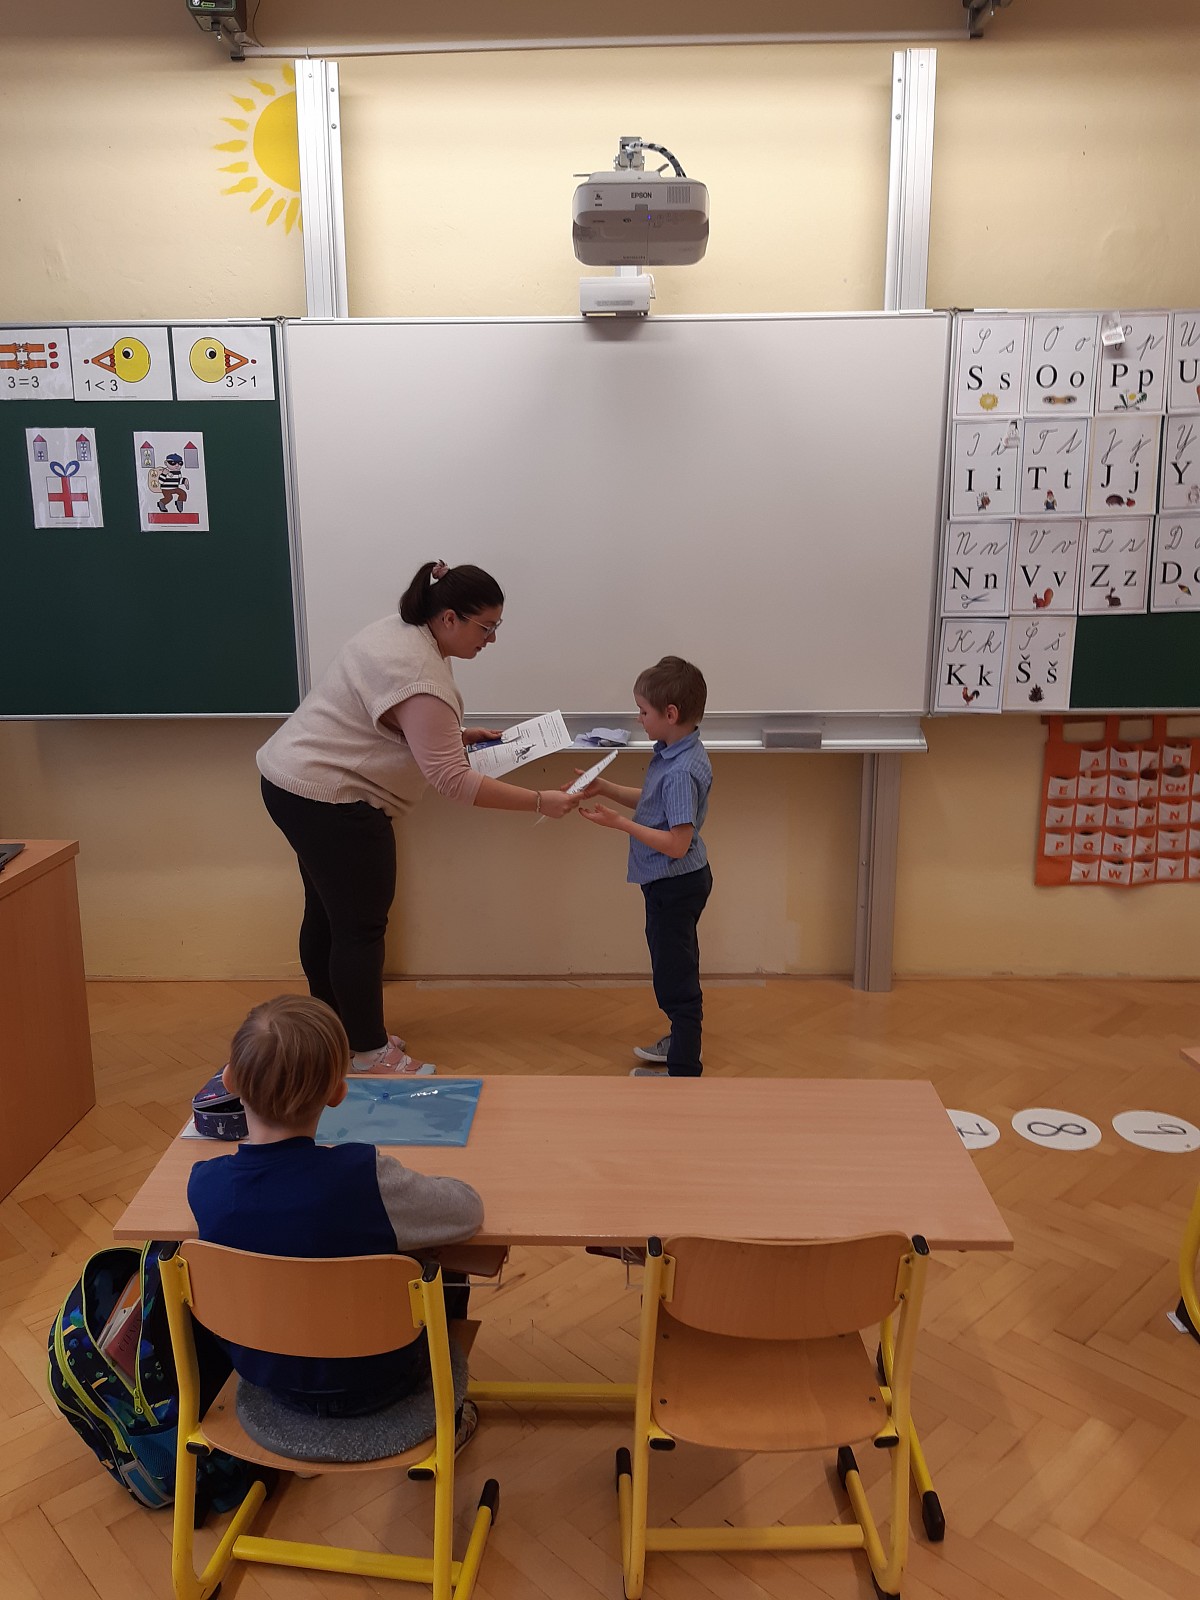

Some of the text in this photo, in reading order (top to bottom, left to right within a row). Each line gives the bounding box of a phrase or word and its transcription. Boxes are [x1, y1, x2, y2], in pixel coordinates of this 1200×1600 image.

[967, 366, 1011, 390] S s
[1036, 365, 1084, 388] O o
[1111, 364, 1153, 392] P p
[1178, 359, 1200, 383] U
[965, 468, 1002, 492] I i
[1028, 467, 1071, 490] T t
[1100, 462, 1140, 493] J j
[1171, 461, 1192, 484] Y
[952, 567, 998, 589] N n
[1020, 565, 1067, 587] V v
[1090, 564, 1137, 587] Z z
[1161, 562, 1182, 584] D
[946, 664, 993, 687] K k
[1016, 654, 1058, 683] Š š
[1091, 758, 1099, 767] A
[1119, 758, 1127, 767] B
[1059, 783, 1185, 795] E F G CH
[1055, 815, 1064, 823] J
[1085, 814, 1095, 822] K
[1116, 816, 1124, 824] L
[1170, 811, 1179, 820] N
[1055, 842, 1064, 850] P
[1083, 843, 1093, 851] Q
[1113, 843, 1122, 852] R
[1170, 839, 1179, 848] T
[1081, 870, 1090, 878] V
[1108, 870, 1122, 879] W
[1169, 866, 1177, 875] Y
[1027, 1121, 1087, 1137] 8
